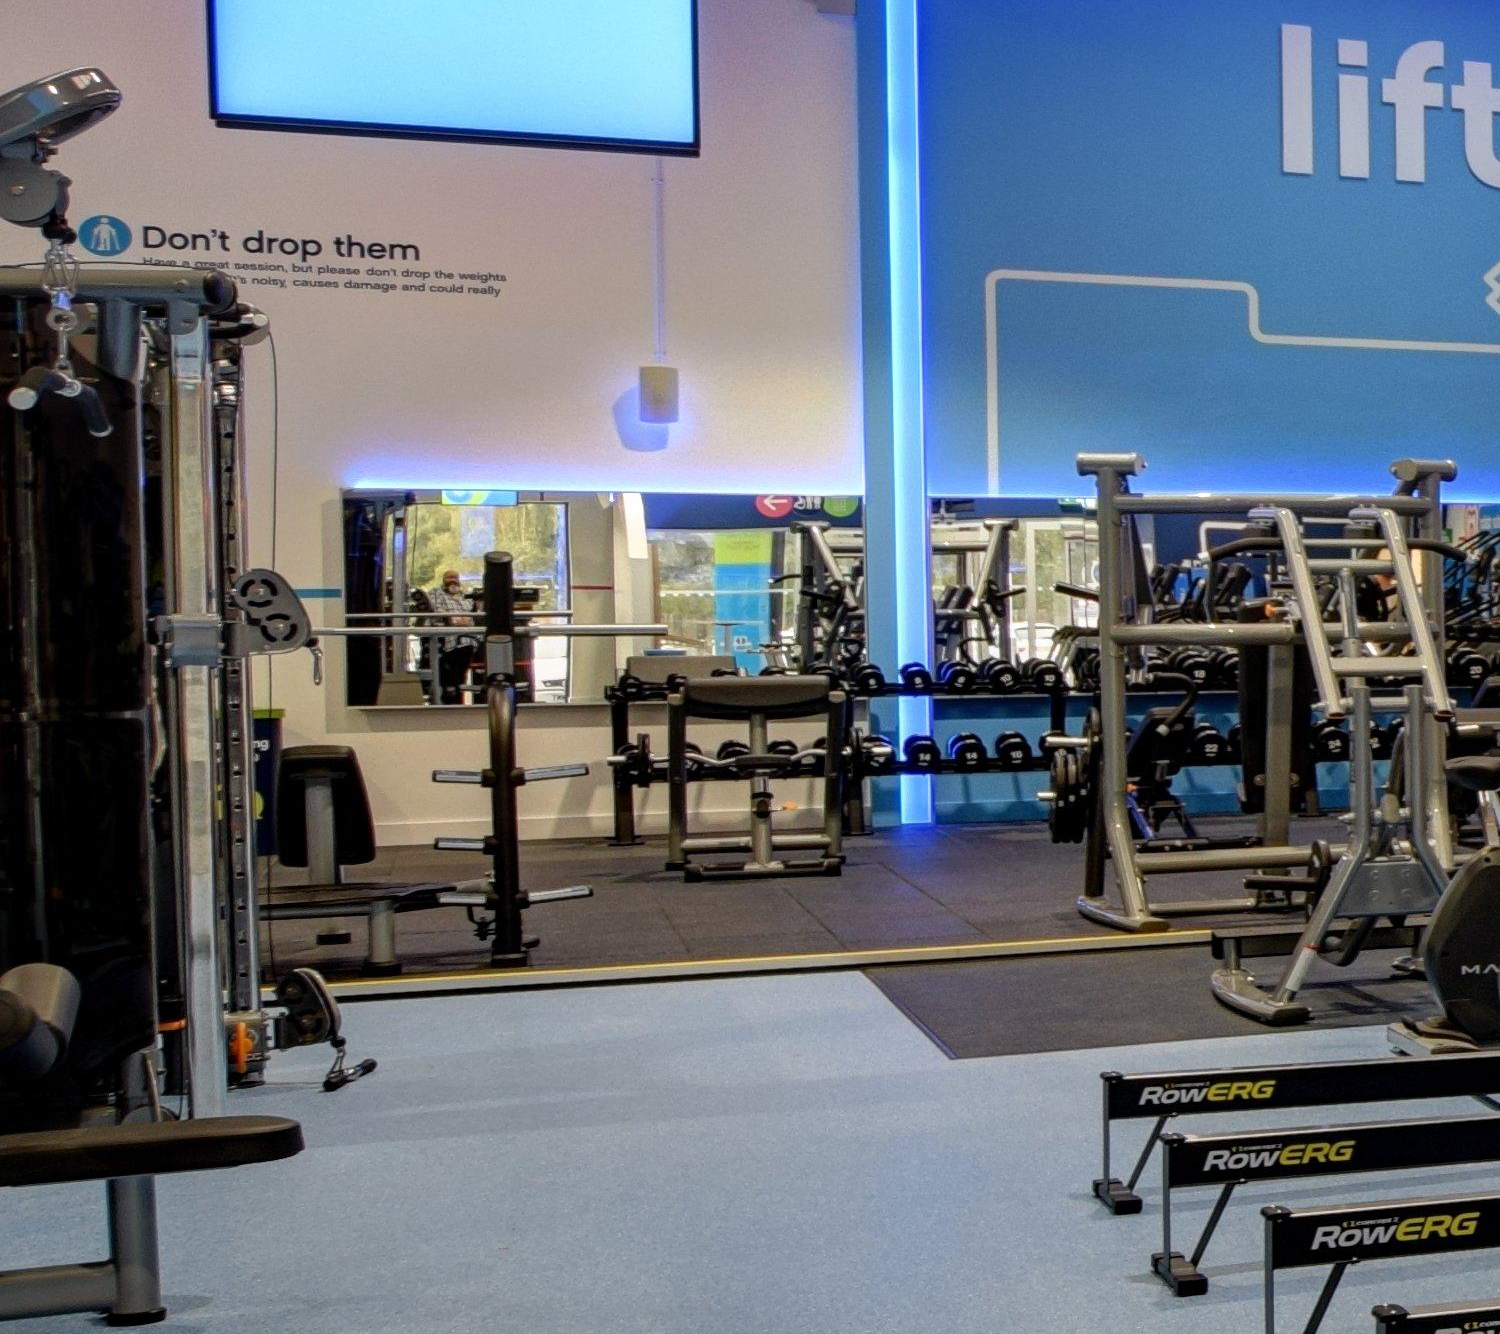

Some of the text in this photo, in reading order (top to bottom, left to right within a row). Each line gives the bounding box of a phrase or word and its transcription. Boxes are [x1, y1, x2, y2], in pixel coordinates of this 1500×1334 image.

[142, 225, 421, 262] Don't drop them
[291, 264, 314, 274] but
[318, 265, 360, 276] please
[401, 268, 431, 281] drop
[434, 269, 455, 280] the
[458, 271, 508, 284] weights
[251, 276, 287, 289] noisy,
[292, 279, 340, 289] causes
[343, 280, 398, 294] damage
[401, 283, 426, 293] and
[429, 283, 464, 294] could
[467, 285, 502, 298] really
